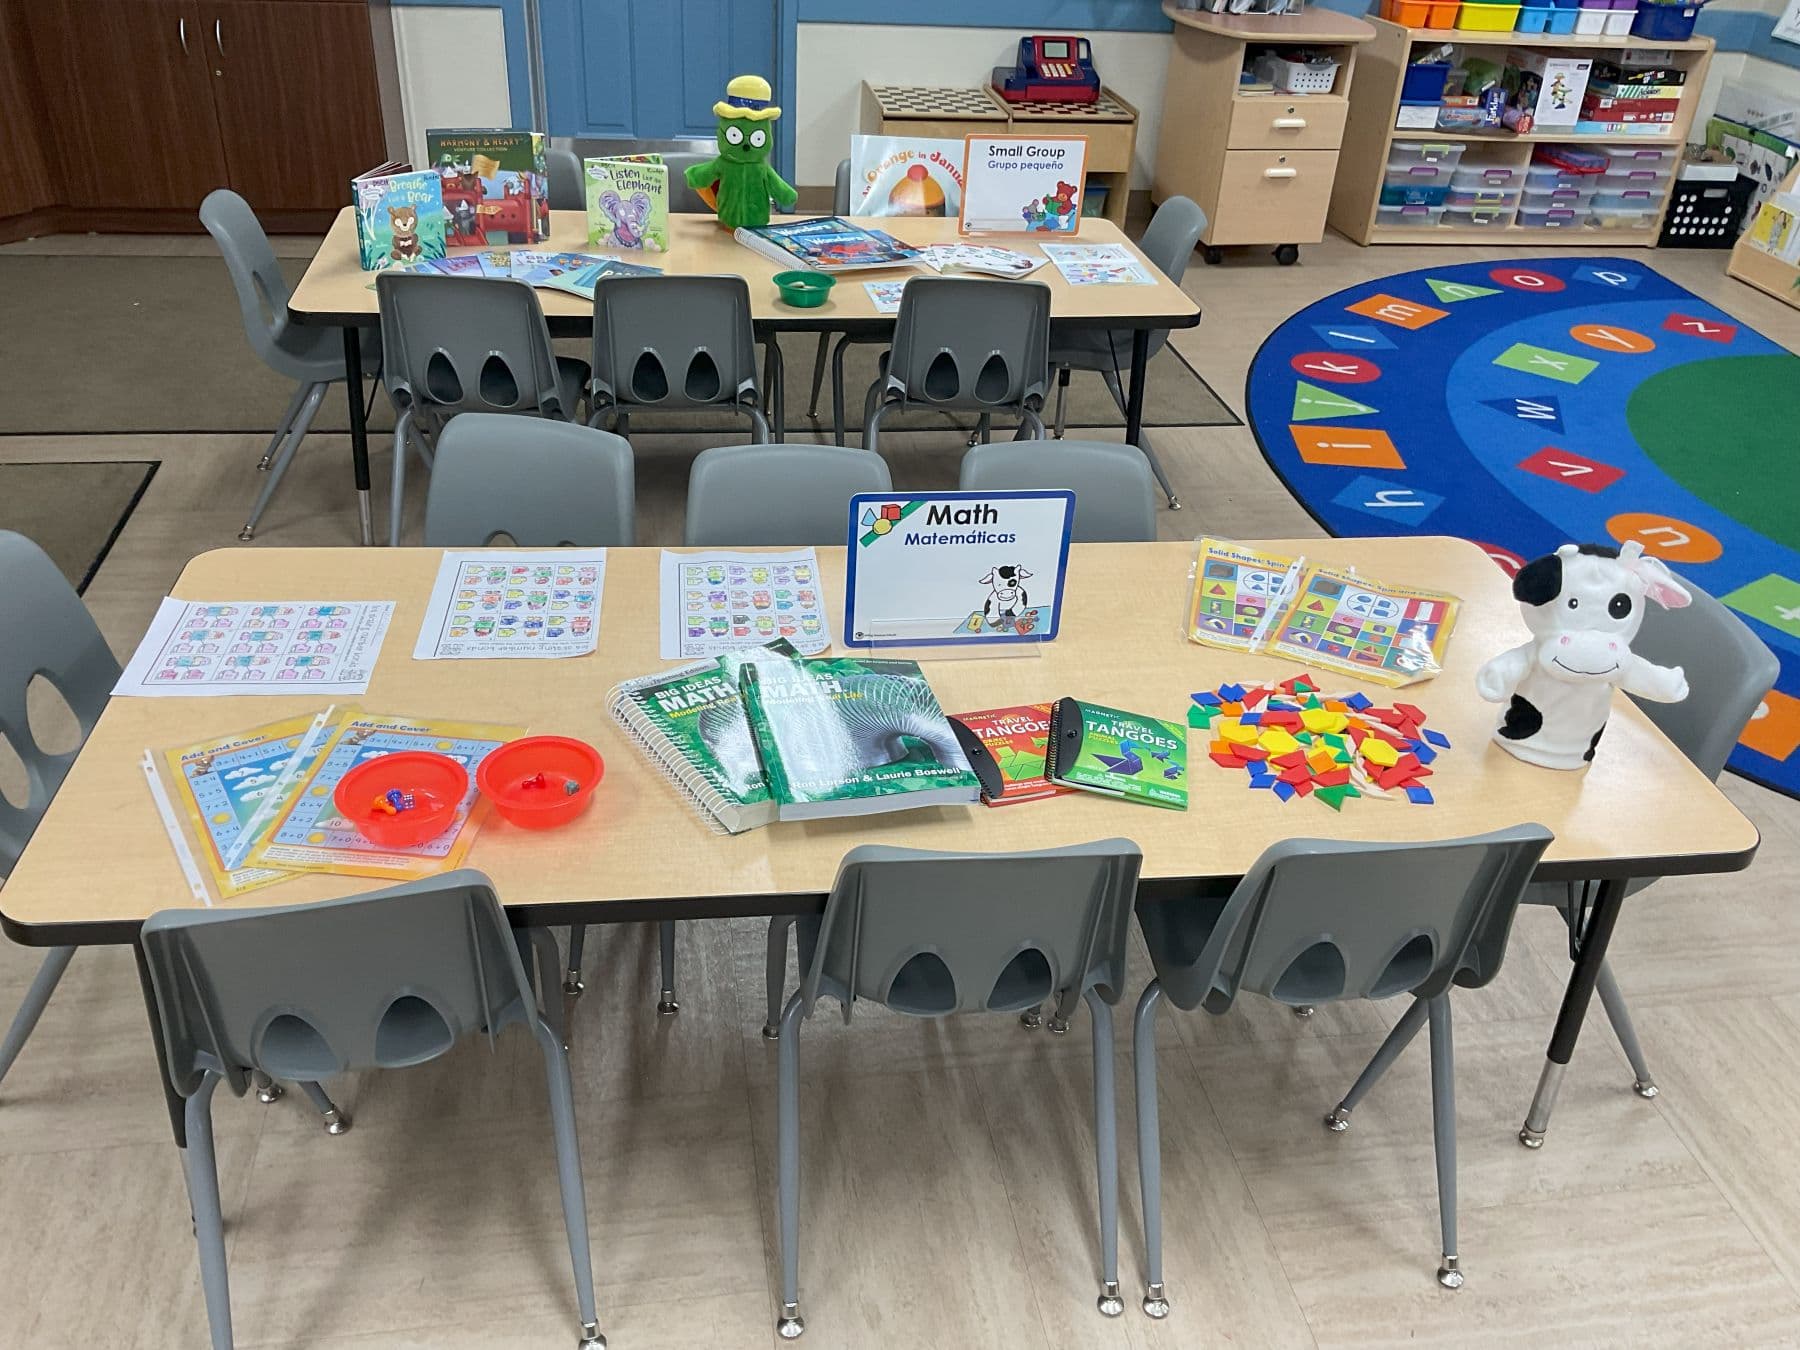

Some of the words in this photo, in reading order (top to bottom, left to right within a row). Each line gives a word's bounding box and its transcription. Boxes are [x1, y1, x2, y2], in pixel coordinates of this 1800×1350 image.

[988, 145, 1021, 158] Small
[1026, 146, 1066, 160] Group
[867, 149, 915, 183] Orange
[918, 151, 927, 160] in
[988, 160, 1018, 171] Grupo
[1021, 160, 1064, 171] pequeño
[609, 167, 640, 181] Listen
[389, 177, 428, 193] Breathe
[616, 179, 662, 194] Elephant
[407, 190, 434, 203] Bear
[772, 223, 833, 236] Wonders
[804, 235, 865, 245] Wonders
[1512, 275, 1545, 287] o
[1440, 284, 1479, 298] n
[1375, 303, 1422, 321] m
[1682, 321, 1721, 333] z
[1586, 328, 1636, 349] y
[1304, 359, 1359, 376] k
[1528, 354, 1569, 371] x
[1300, 397, 1367, 412] j
[1515, 398, 1556, 420] w
[1316, 441, 1373, 449] i
[1546, 460, 1594, 477] v
[1363, 489, 1425, 508] h
[926, 503, 999, 526] Math
[904, 530, 1017, 546] Matemáticas
[1208, 547, 1230, 557] Solid
[1231, 552, 1265, 564] Shapes:
[1266, 559, 1286, 568] Spin
[654, 688, 680, 701] BIG
[682, 676, 722, 694] IDEAS
[842, 692, 863, 700] Life
[657, 682, 739, 713] MATH
[669, 702, 717, 719] Modeling
[962, 713, 997, 721] MAGNETIC
[1084, 708, 1121, 719] MAGNETIC
[351, 721, 374, 730] Add
[376, 723, 397, 731] and
[399, 725, 432, 733] Cover
[991, 715, 1035, 727] TRAVEL
[1111, 720, 1155, 735] TRAVEL
[971, 720, 1052, 739] TANGOE
[1085, 720, 1179, 750] TANGOES
[180, 750, 205, 762] Add
[207, 743, 231, 755] and
[233, 735, 267, 747] Cover
[863, 773, 874, 783] &
[876, 770, 914, 781] Laurie
[914, 766, 961, 777] Boswell
